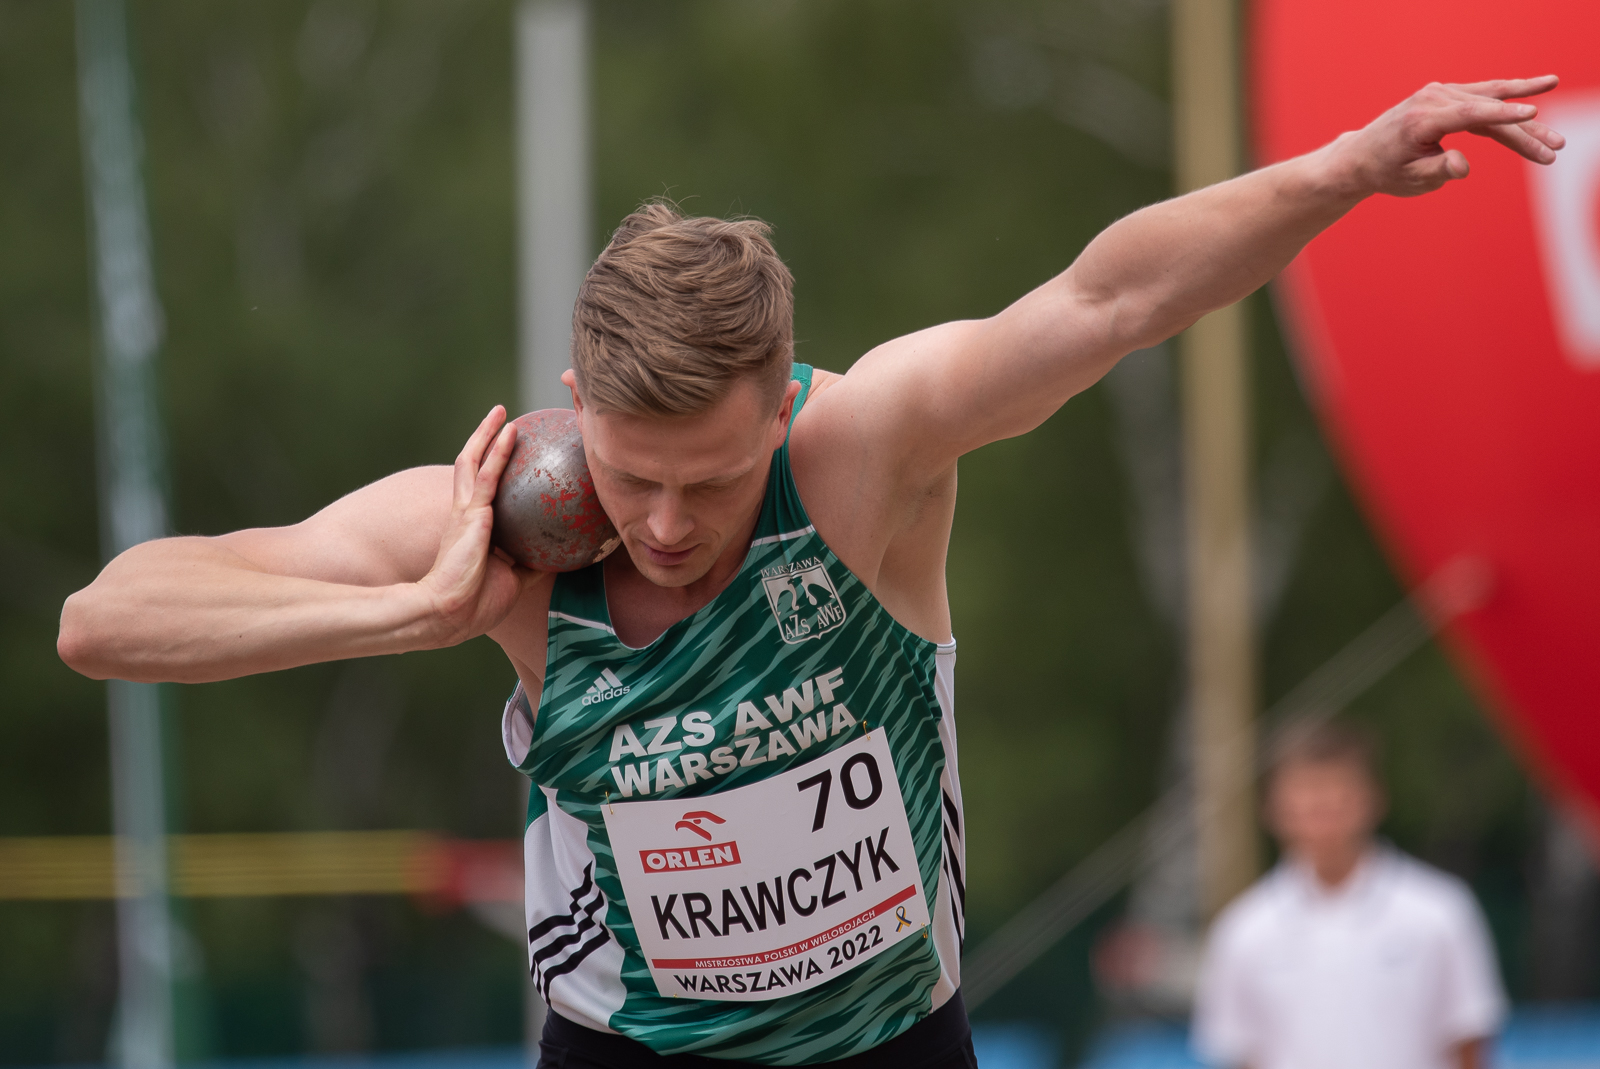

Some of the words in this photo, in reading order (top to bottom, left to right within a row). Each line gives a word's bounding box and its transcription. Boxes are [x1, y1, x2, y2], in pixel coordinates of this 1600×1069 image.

[760, 556, 822, 578] WARSZAWA
[785, 614, 811, 640] AZS
[817, 602, 842, 629] AWF
[581, 684, 631, 707] adidas
[608, 711, 716, 762] AZS
[734, 666, 844, 737] AWF
[611, 703, 857, 798] WARSZAWA
[796, 752, 883, 833] 70
[646, 845, 735, 871] ORLEN
[650, 826, 900, 940] KRAWCZYK
[673, 957, 824, 994] WARSZAWA
[827, 924, 884, 969] 2022
[695, 956, 762, 968] MISTRZOSTWA
[764, 946, 798, 961] POLSKI
[799, 942, 809, 951] W
[810, 910, 876, 947] WIELOBOJACH
